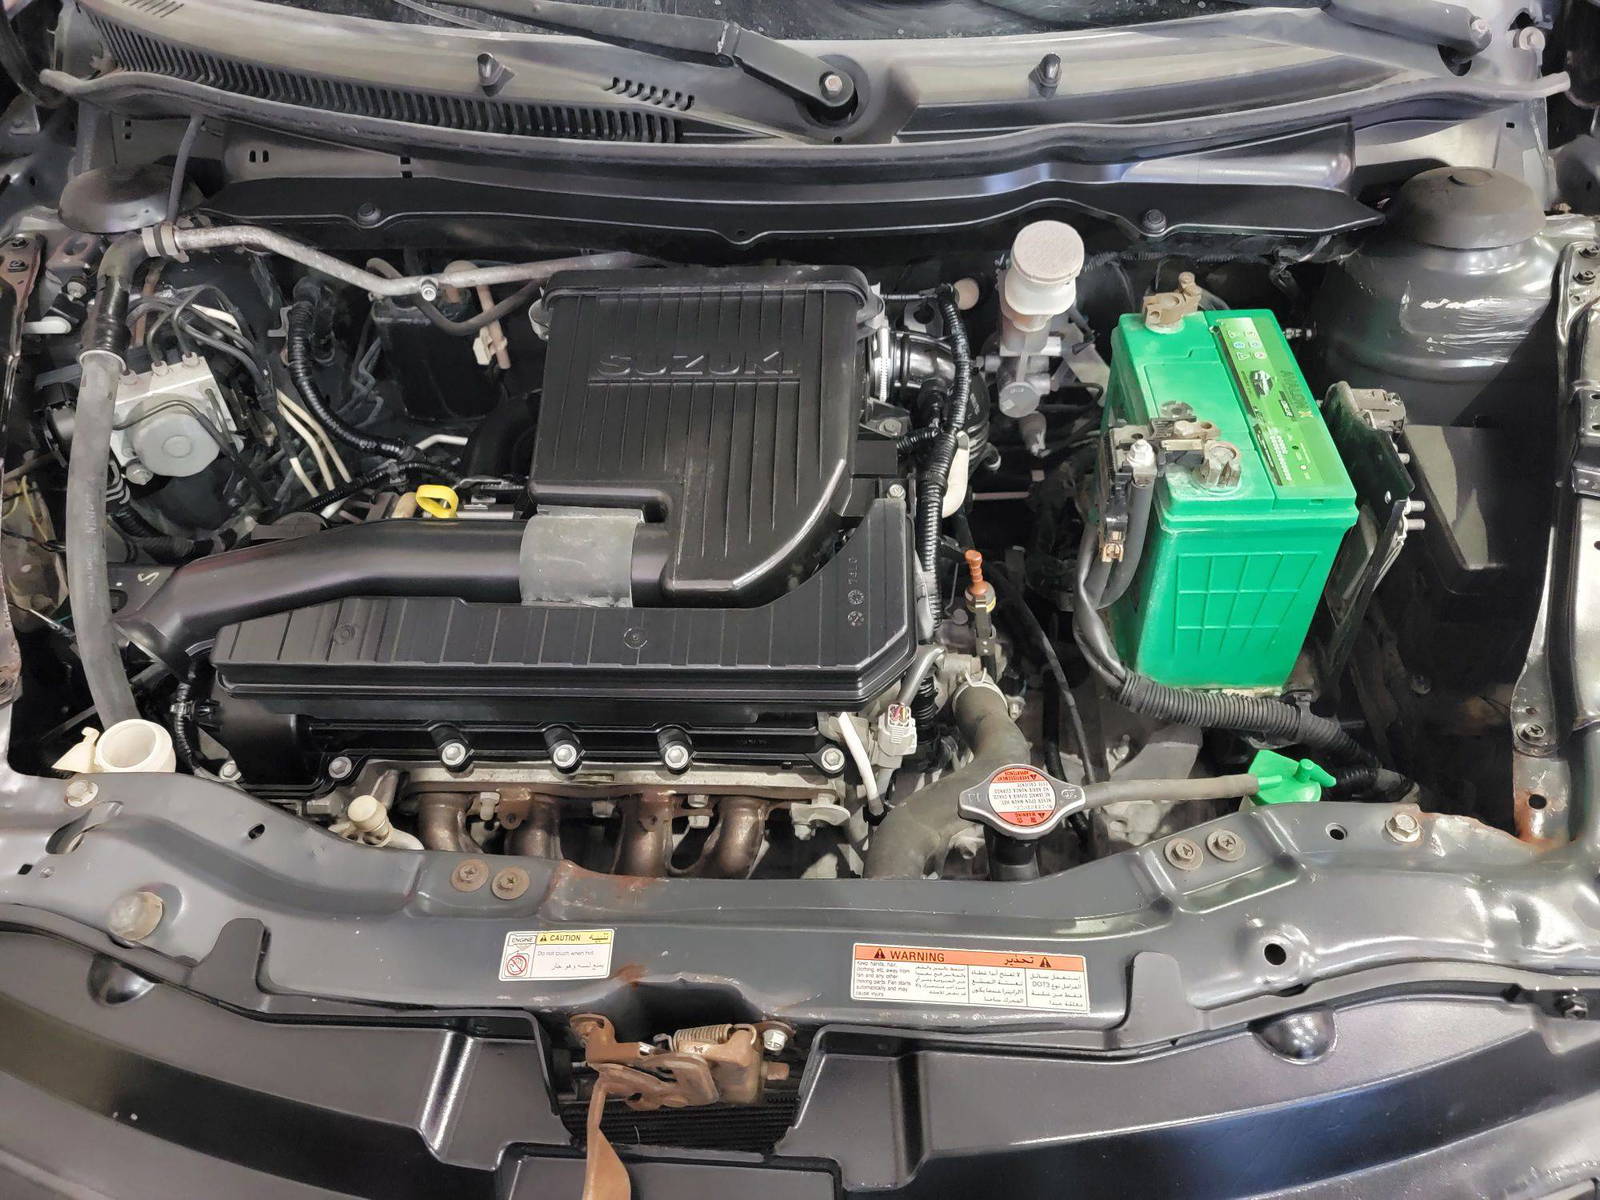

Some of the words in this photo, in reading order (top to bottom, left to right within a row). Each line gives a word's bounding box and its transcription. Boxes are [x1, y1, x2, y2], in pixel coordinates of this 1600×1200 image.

[596, 350, 794, 377] SUZUKI
[890, 950, 945, 962] WARNING
[1004, 954, 1034, 966] تحذير
